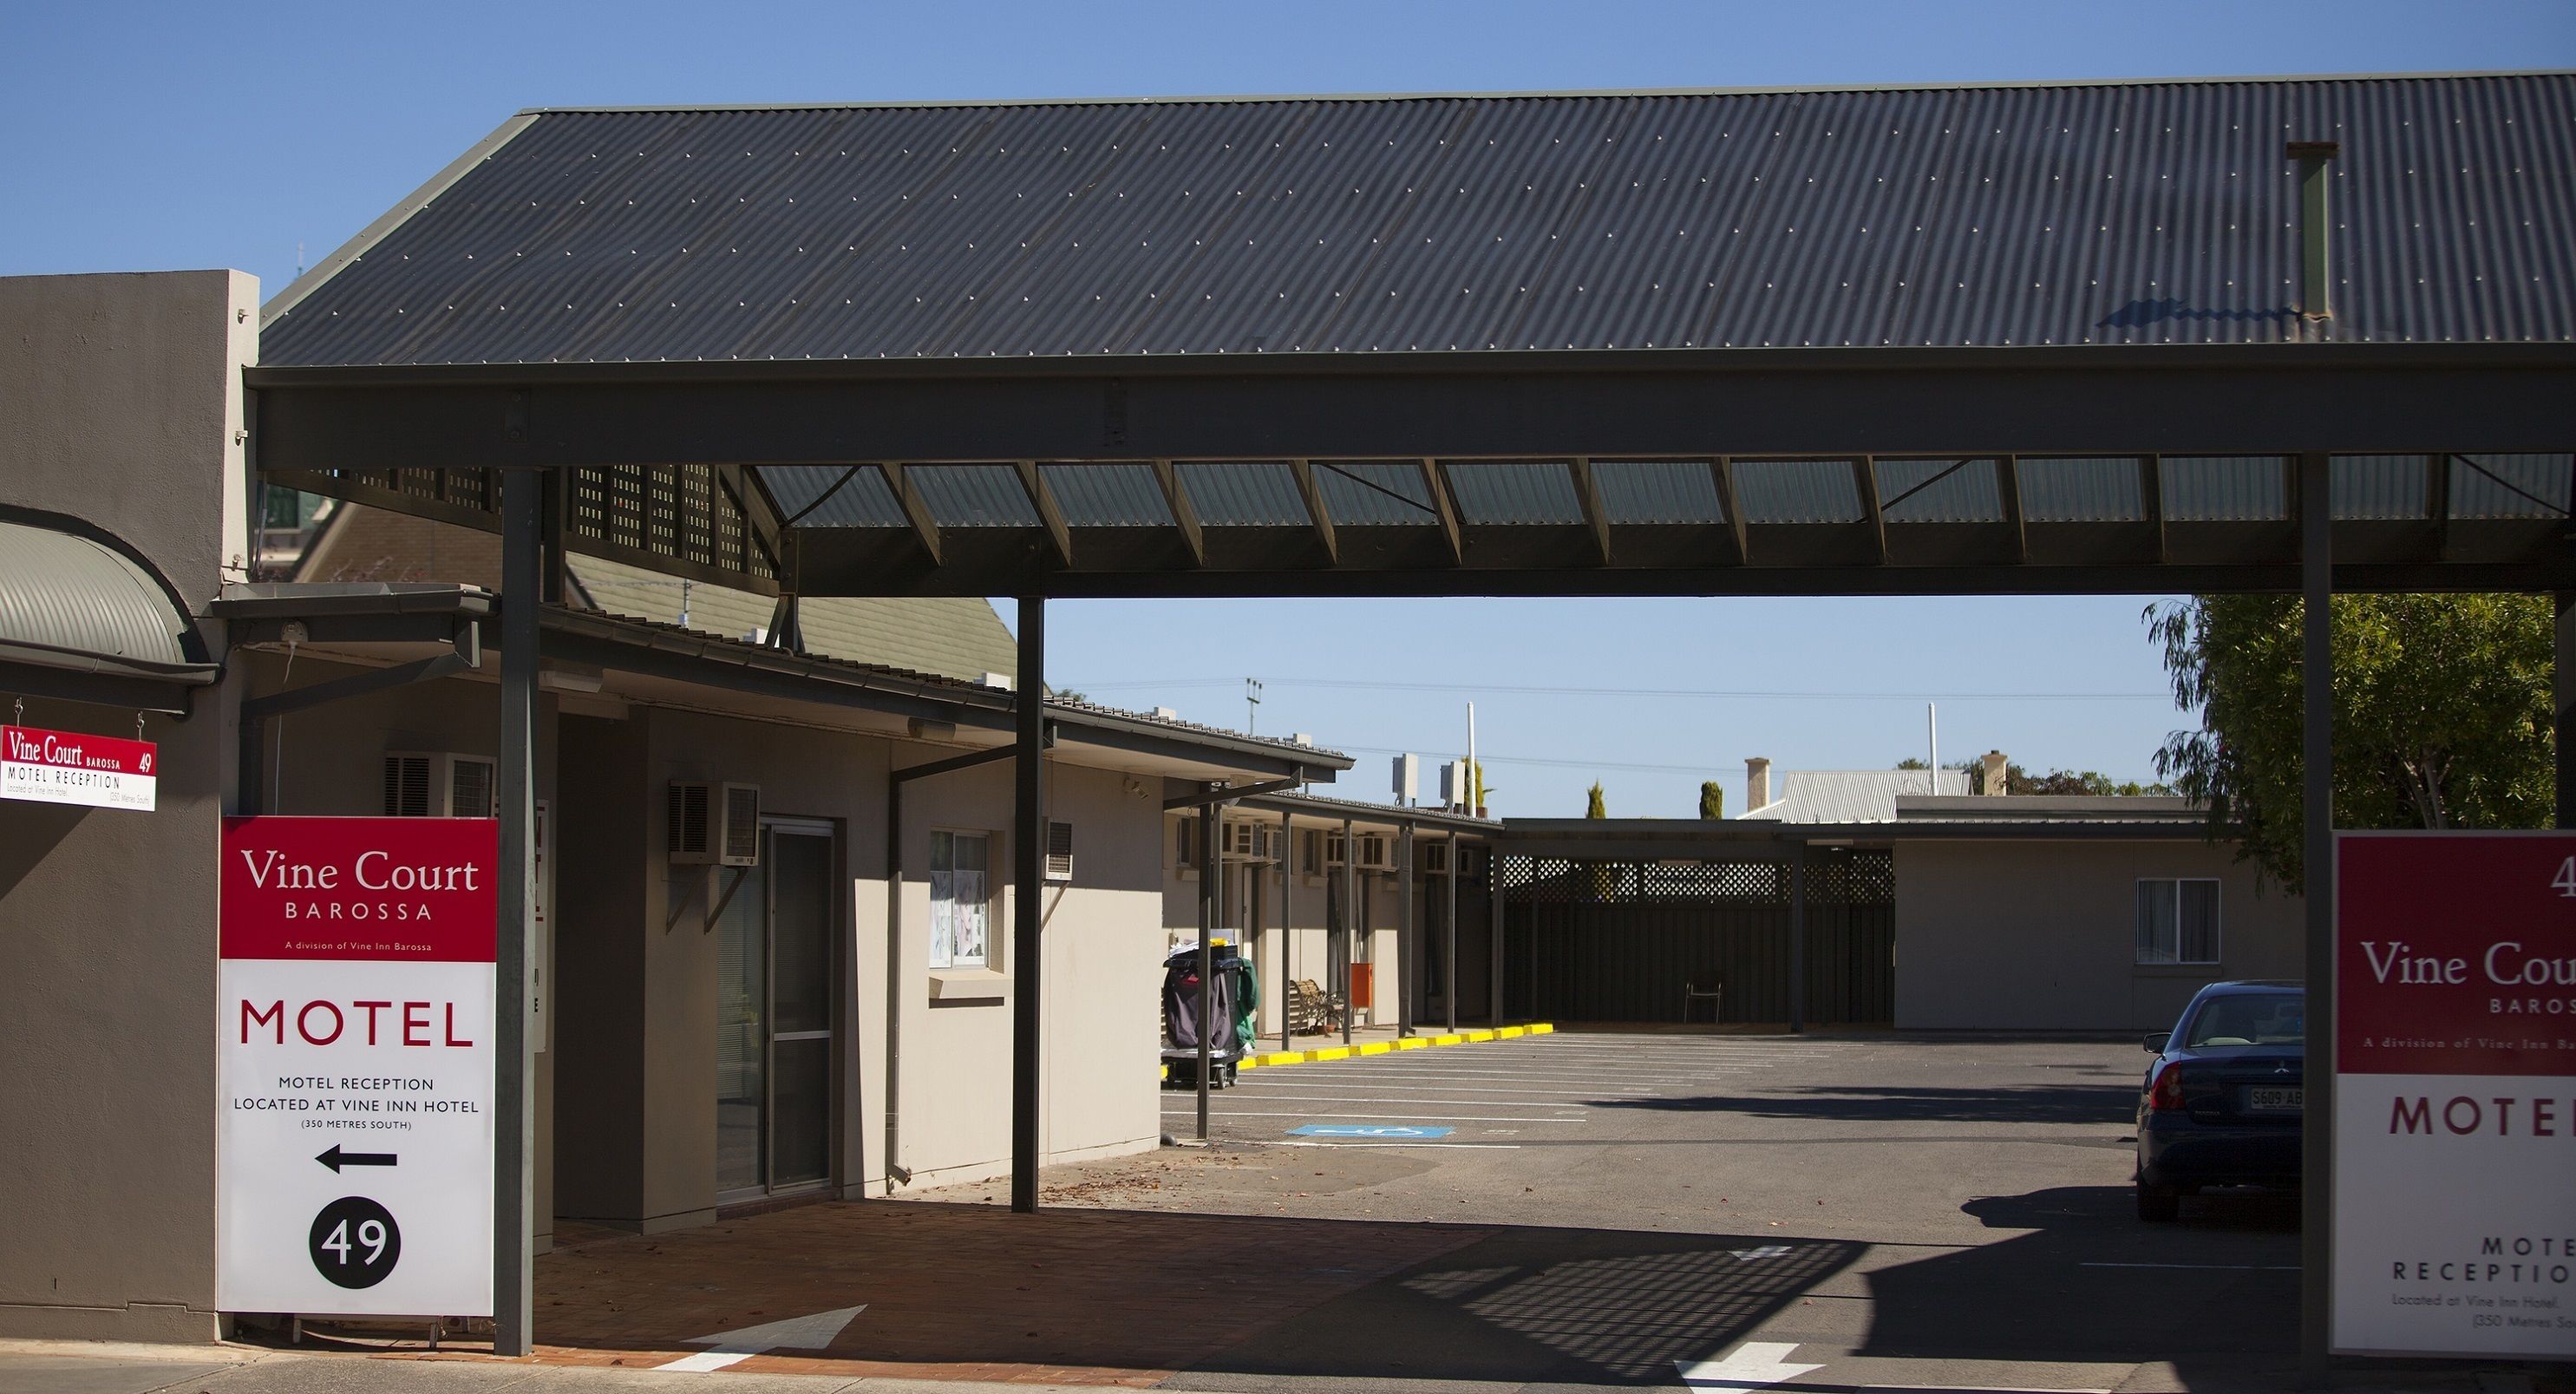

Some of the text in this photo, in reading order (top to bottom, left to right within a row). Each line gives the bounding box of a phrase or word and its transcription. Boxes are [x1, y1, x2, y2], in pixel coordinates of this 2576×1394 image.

[9, 730, 152, 773] Vine Court BAROSSA 49
[8, 766, 119, 789] MOTEL RECEPTION
[240, 849, 479, 891] Vine Court
[285, 902, 431, 920] BAROSSA
[296, 941, 333, 950] division
[337, 941, 347, 950] of
[350, 942, 372, 951] Vine
[376, 942, 390, 951] Inn
[394, 942, 432, 952] Barossa
[2360, 941, 2468, 985] Vine
[241, 999, 474, 1047] MOTEL
[2363, 1037, 2374, 1048] A
[2381, 1037, 2446, 1049] division
[2453, 1037, 2471, 1049] of
[2477, 1037, 2514, 1049] Vine
[278, 1077, 434, 1090] MOTEL RECEPTION
[234, 1097, 479, 1113] LOCATED AT VINE INN HOTEL
[301, 1119, 412, 1131] (350 METRES SOUTH)
[321, 1219, 387, 1266] 49
[2481, 1237, 2575, 1257] MOTE
[2393, 1262, 2569, 1284] RECEPTIO
[2392, 1293, 2442, 1306] Located
[2465, 1295, 2494, 1307] Vine
